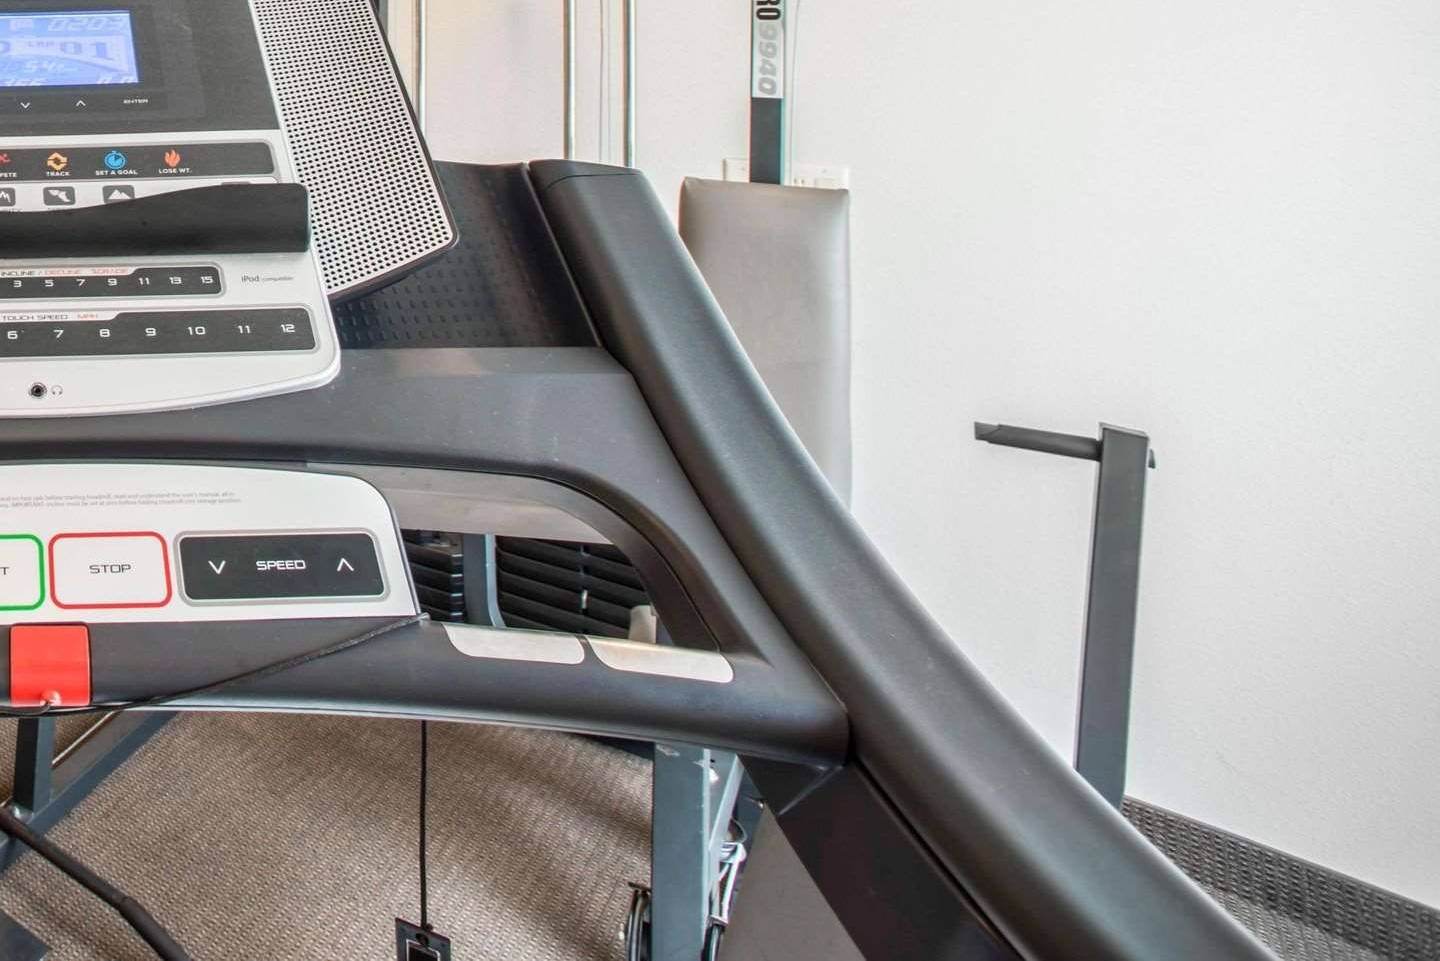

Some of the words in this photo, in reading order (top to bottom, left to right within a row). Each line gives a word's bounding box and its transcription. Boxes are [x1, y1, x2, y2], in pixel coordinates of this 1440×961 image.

[758, 24, 779, 96] 9940
[44, 279, 54, 287] 5
[76, 278, 86, 286] 7
[107, 278, 117, 286] 9
[138, 277, 150, 285] 11
[169, 276, 182, 284] 13
[200, 275, 214, 284] 15
[241, 275, 259, 283] iPod
[7, 331, 18, 340] 6
[53, 329, 64, 338] 7
[99, 328, 111, 337] 8
[145, 327, 157, 337] 9
[187, 326, 206, 335] 10
[237, 325, 251, 334] 11
[280, 324, 295, 333] 12
[88, 563, 132, 575] STOP
[255, 559, 307, 573] SPEED
